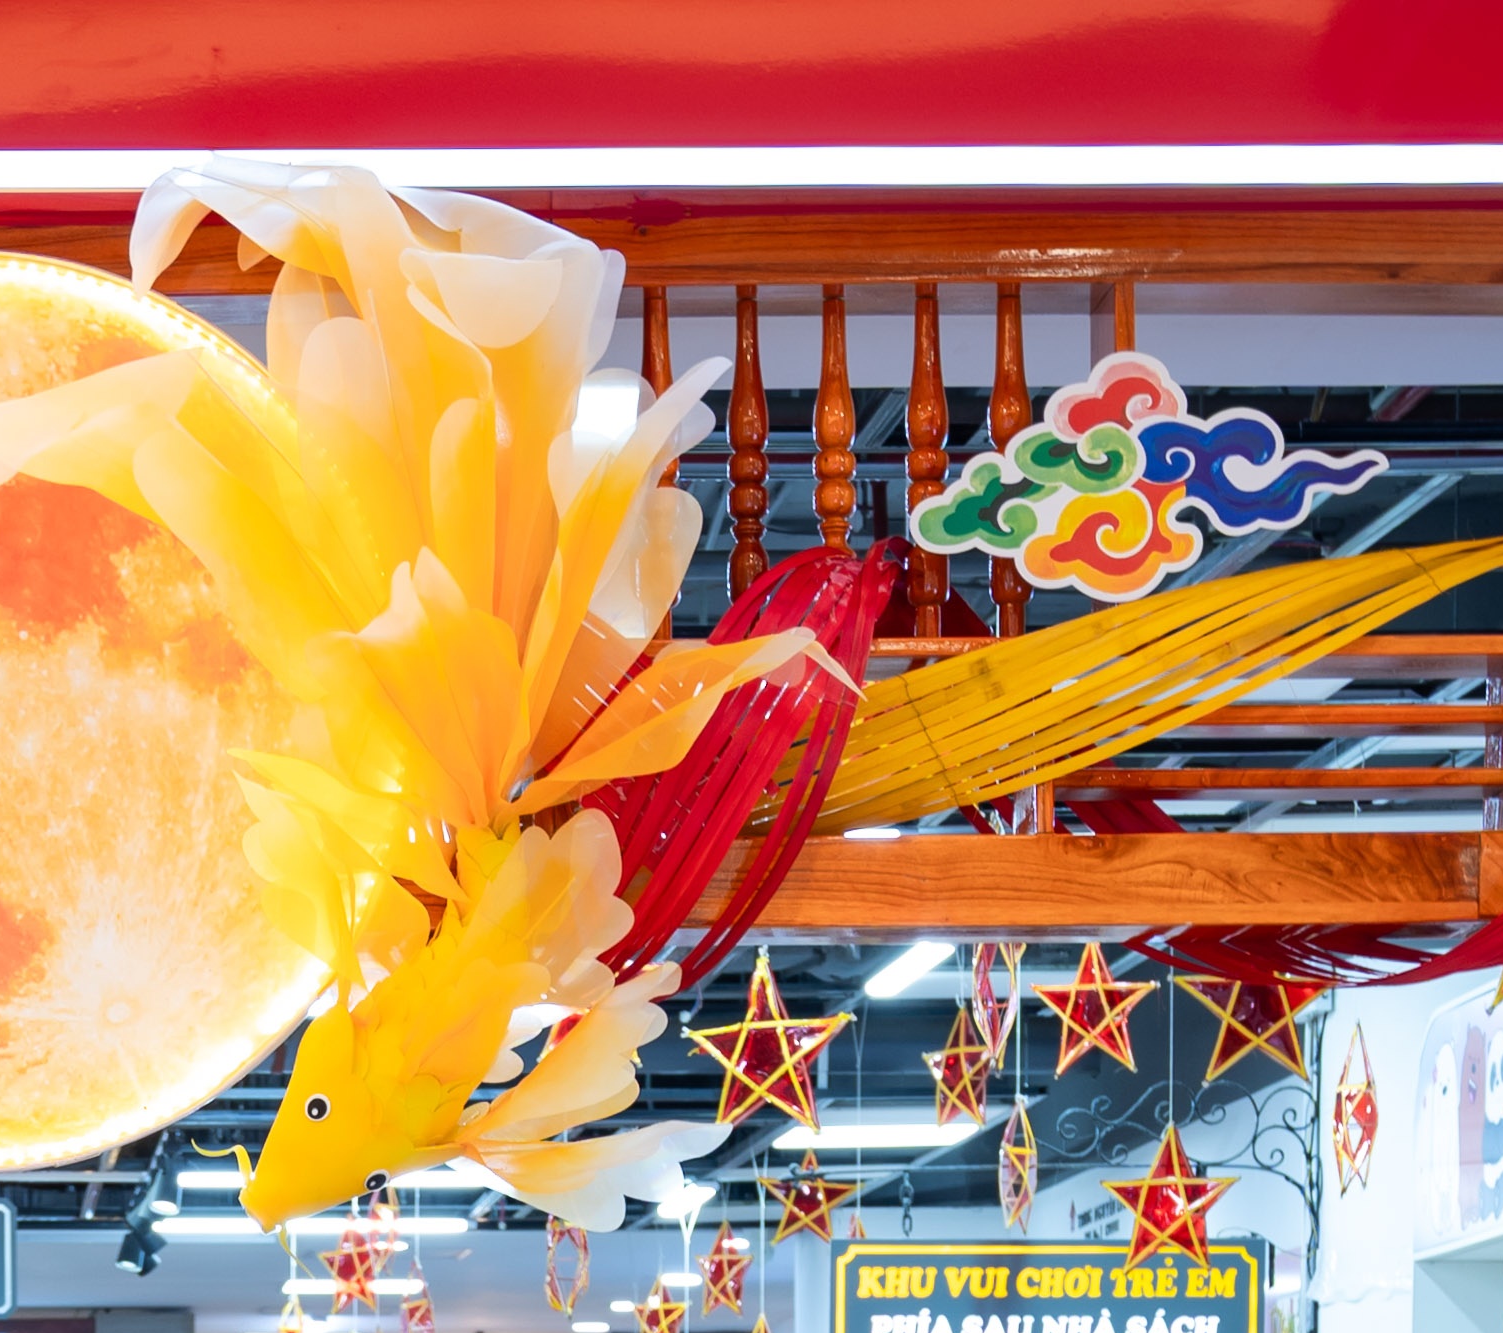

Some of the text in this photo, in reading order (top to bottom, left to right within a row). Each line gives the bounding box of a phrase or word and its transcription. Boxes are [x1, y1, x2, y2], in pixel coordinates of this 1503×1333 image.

[856, 1256, 1238, 1299] KHU VUI CHƠI TRẺ EM
